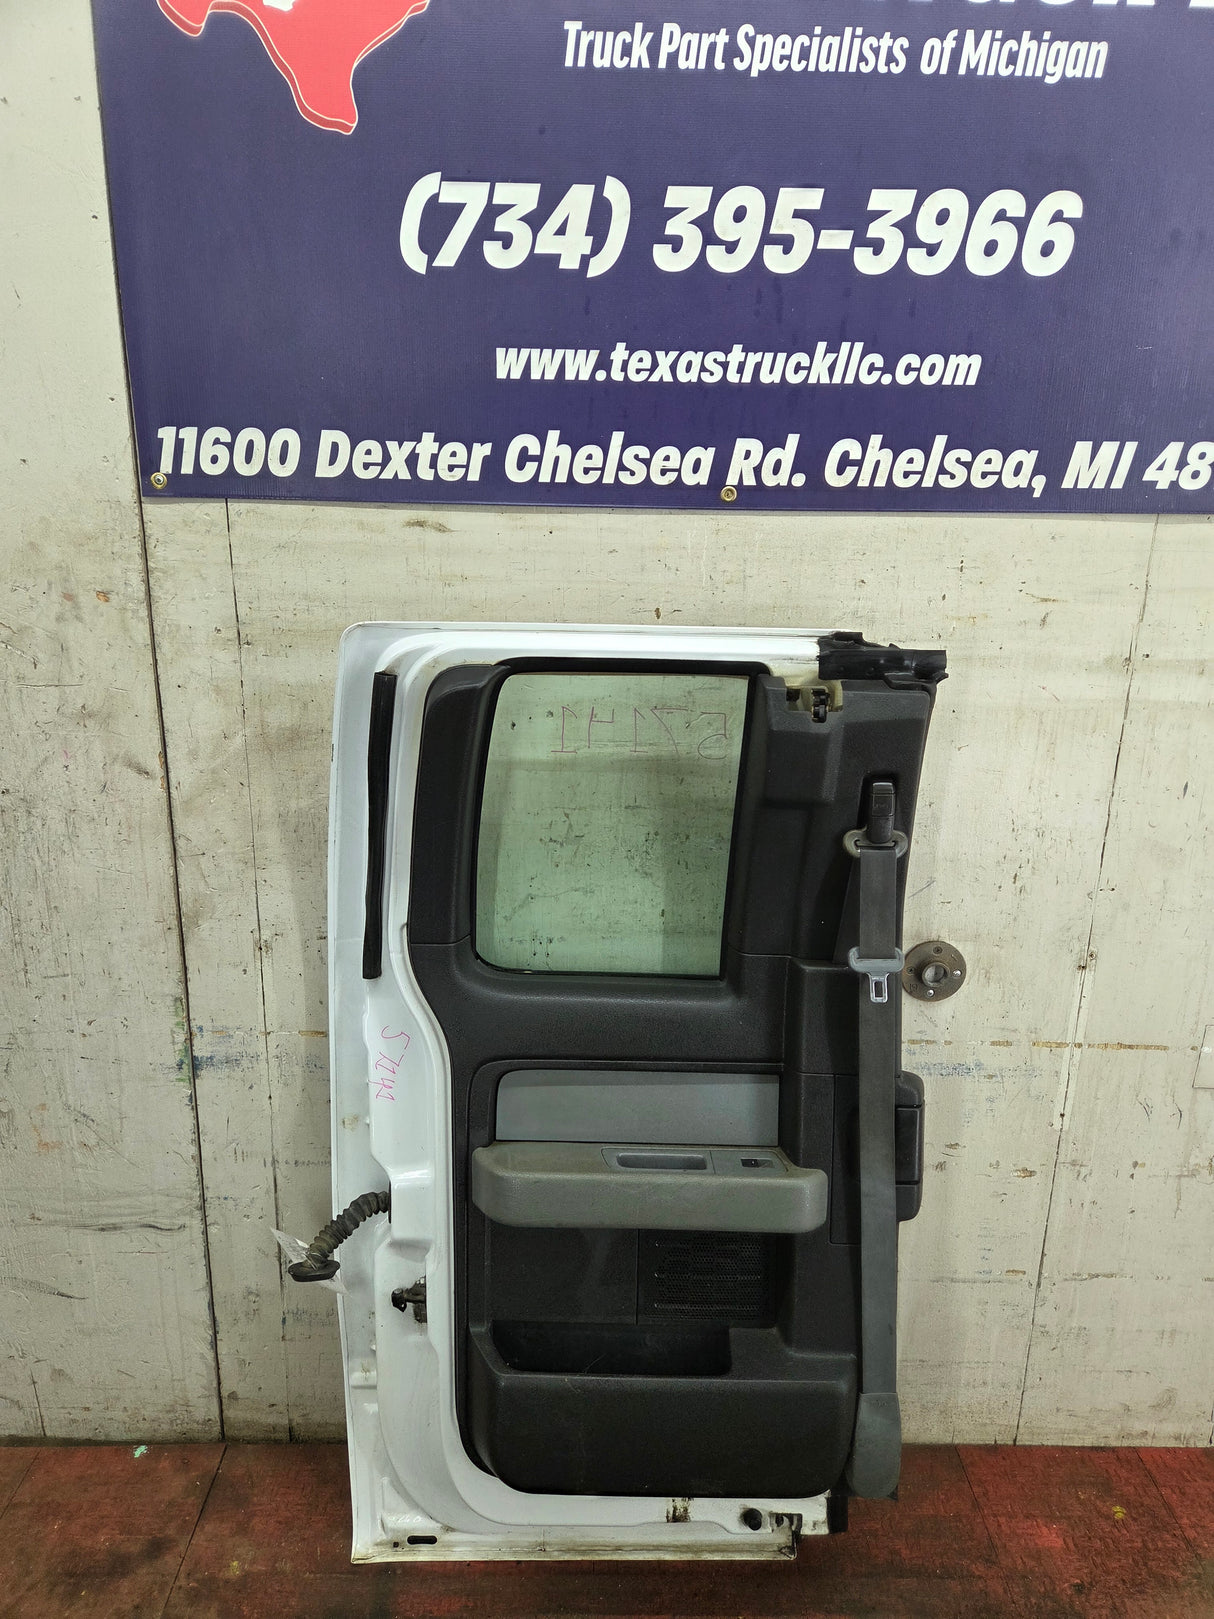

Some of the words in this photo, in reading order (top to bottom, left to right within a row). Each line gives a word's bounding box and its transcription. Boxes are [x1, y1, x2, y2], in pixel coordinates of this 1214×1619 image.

[564, 21, 655, 71] Truck
[657, 23, 730, 72] Part
[732, 24, 910, 79] Specialists
[919, 28, 959, 76] of
[957, 29, 1110, 85] Michigan
[399, 171, 631, 279] (734)
[652, 185, 1084, 277] 395-3966
[495, 341, 982, 388] www.texastruckllc.com
[155, 426, 301, 480] 11600
[314, 429, 493, 485] Dexter
[504, 429, 716, 487] Chelsea
[725, 433, 806, 489] Rd.
[824, 434, 1047, 498] Chelsea,
[1060, 440, 1139, 490] MI
